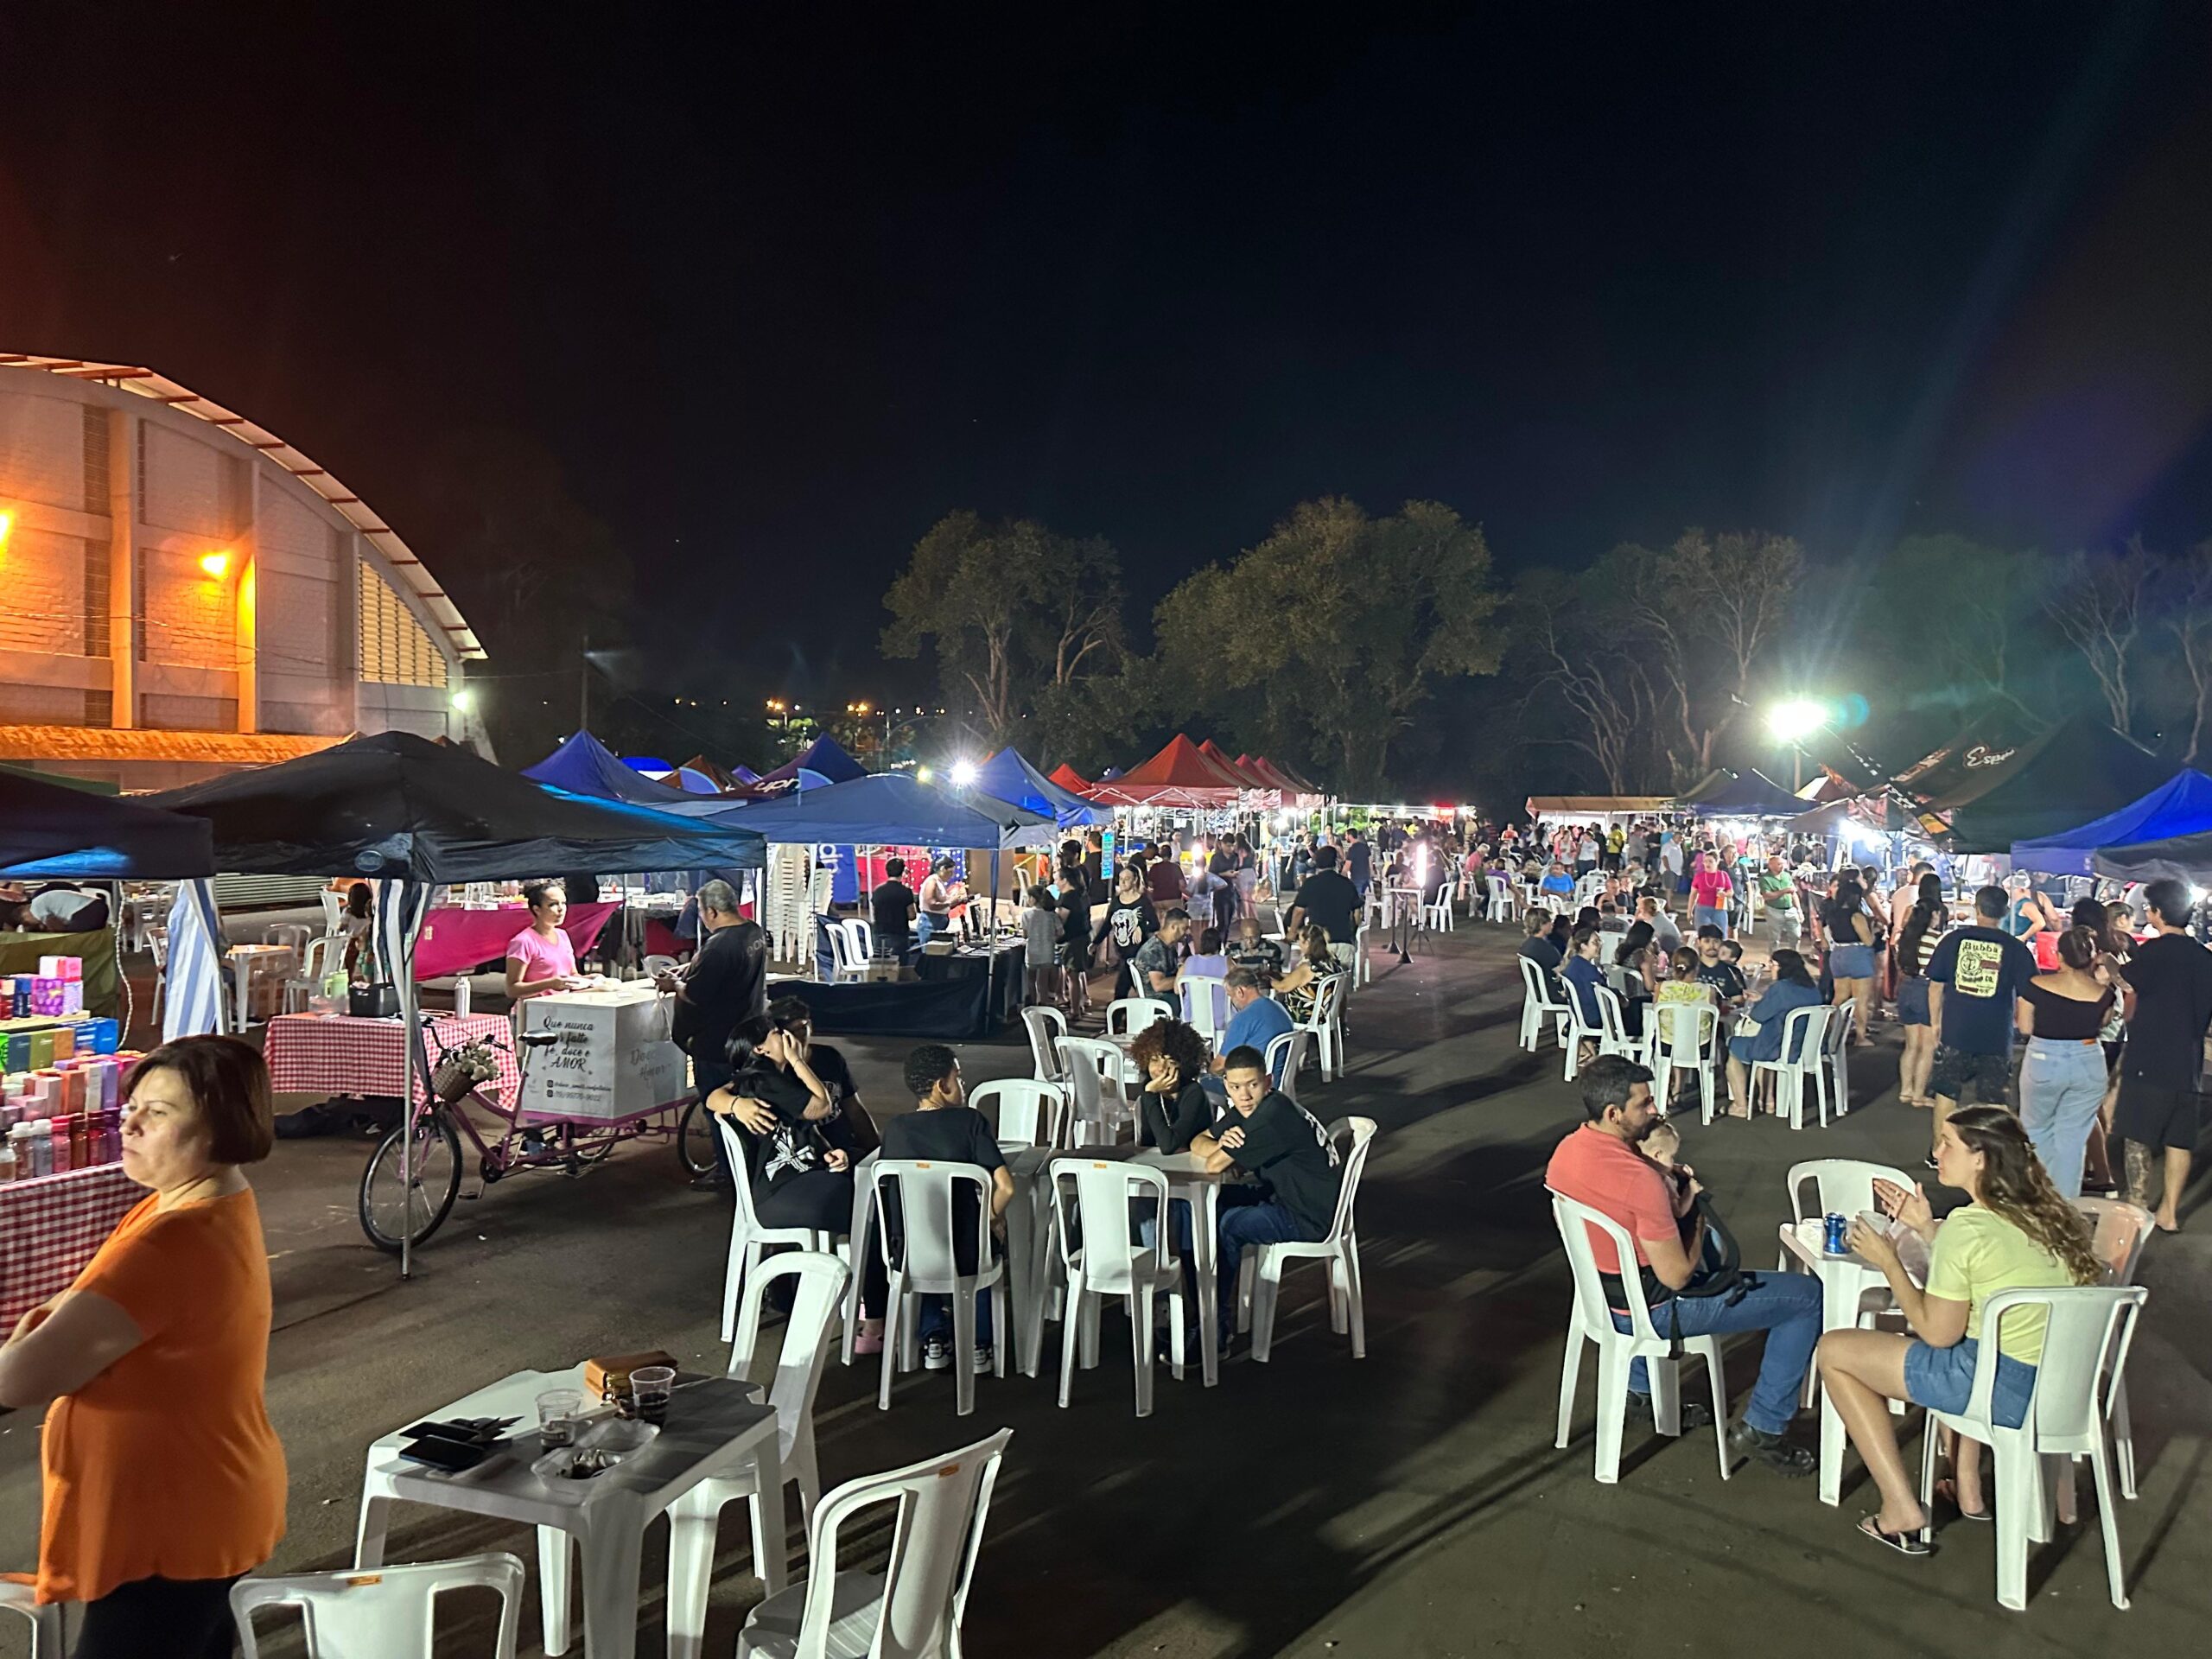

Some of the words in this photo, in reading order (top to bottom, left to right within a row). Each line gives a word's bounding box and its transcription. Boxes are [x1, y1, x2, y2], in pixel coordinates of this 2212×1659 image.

[1962, 942, 1998, 953] Bubba
[543, 1016, 563, 1030] Que
[564, 1021, 594, 1031] nunca
[562, 1047, 582, 1057] doce
[550, 1057, 587, 1072] AMOR
